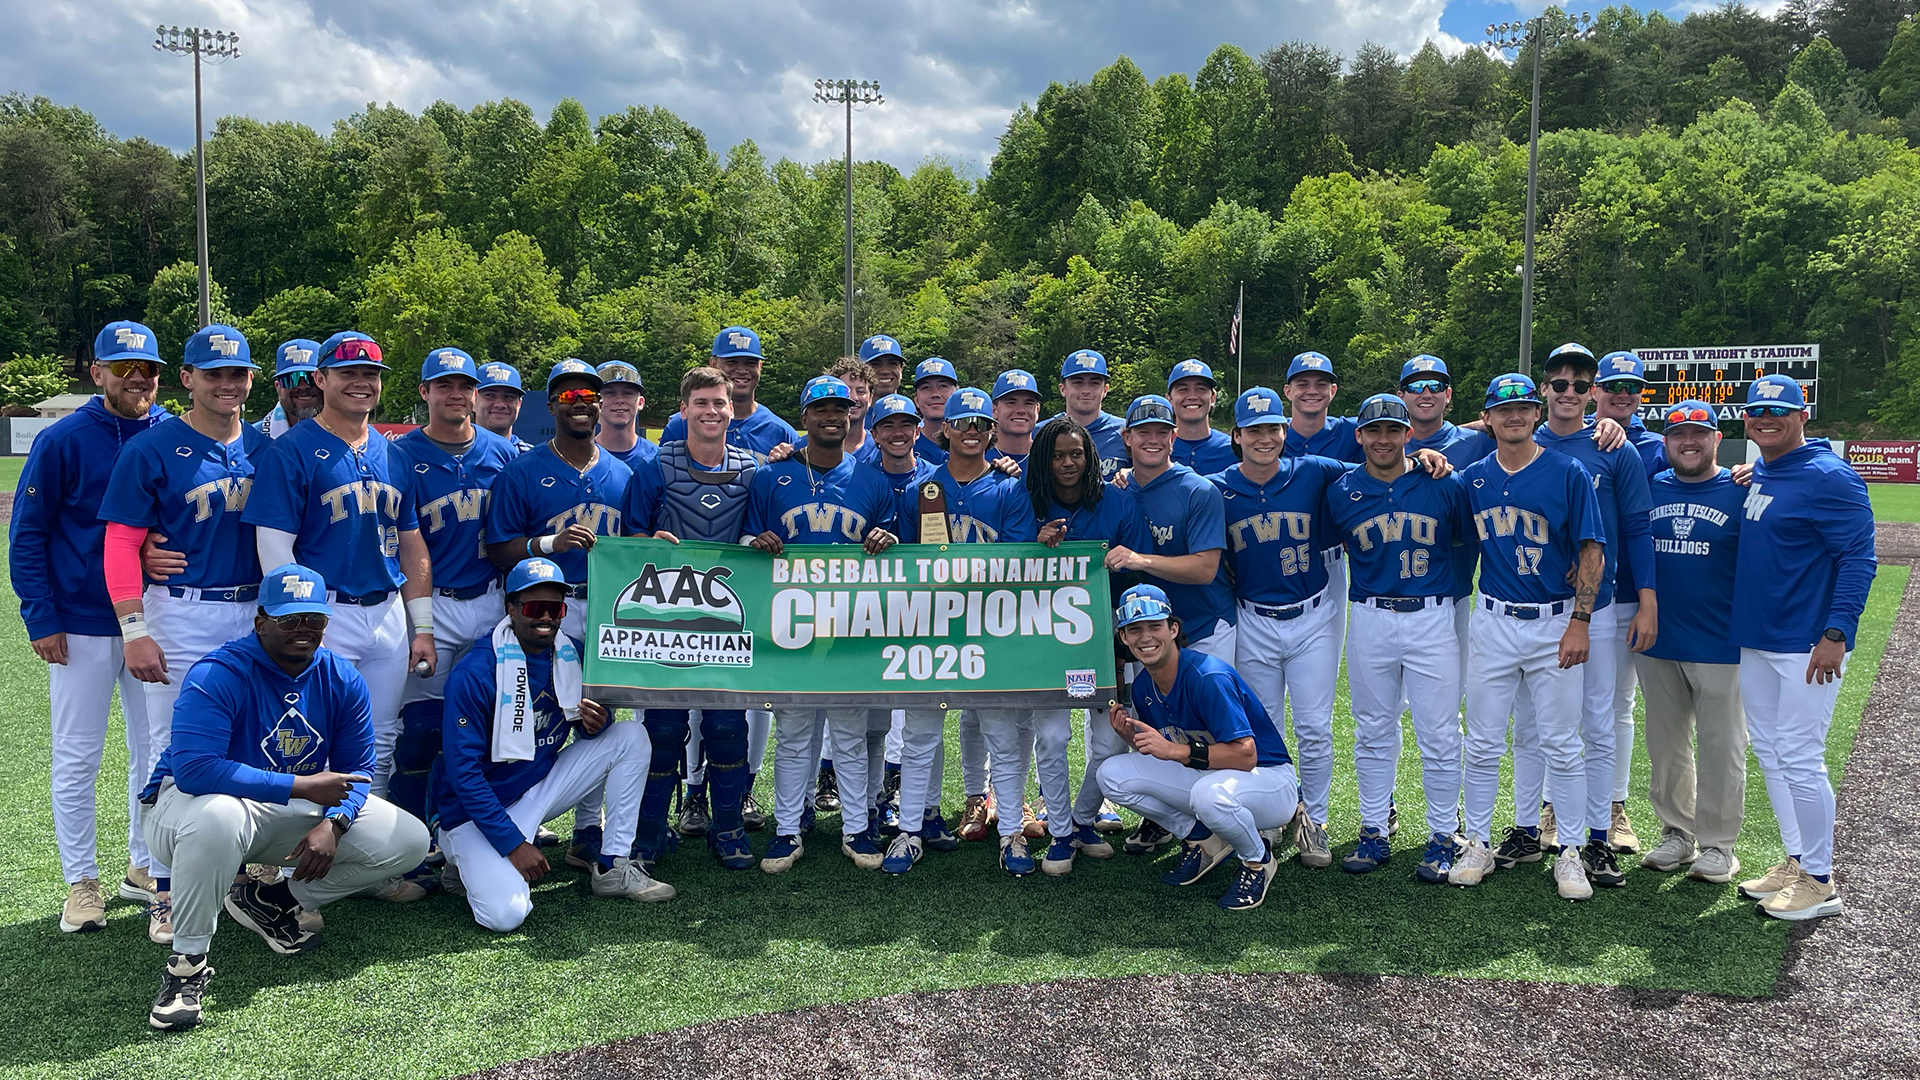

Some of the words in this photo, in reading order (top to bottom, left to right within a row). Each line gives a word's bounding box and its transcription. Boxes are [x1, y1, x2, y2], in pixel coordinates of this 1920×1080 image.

[1637, 349, 1689, 361] HUNTER
[1692, 348, 1748, 360] WRIGHT
[1750, 346, 1812, 358] STADIUM
[1678, 370, 1686, 382] 0
[1715, 369, 1723, 381] 0
[1849, 445, 1882, 454] Always
[1884, 446, 1903, 454] part
[1904, 445, 1915, 453] of
[1849, 454, 1884, 463] YOUR
[1887, 456, 1913, 464] team.
[185, 477, 253, 523] TW
[320, 480, 403, 524] TWU
[420, 488, 492, 533] TW
[1649, 503, 1685, 521] TENNESSEE
[1687, 503, 1729, 527] WESLEYAN
[780, 502, 867, 542] TWU
[949, 513, 999, 544] WU
[1228, 511, 1312, 552] TWU
[1351, 511, 1438, 552] TWU
[1473, 505, 1549, 545] TWU
[1280, 543, 1310, 576] 25
[1515, 545, 1543, 576] 17
[1655, 539, 1710, 555] BULLDOGS
[772, 558, 907, 584] BASEBALL
[916, 555, 1091, 583] TOURNAMENT
[1400, 548, 1430, 579] 16
[630, 562, 734, 608] AAC
[771, 586, 1094, 649] CHAMPIONS
[600, 628, 751, 651] APPALACHIAN
[601, 646, 662, 660] Athletic
[669, 650, 751, 664] Conference
[881, 644, 986, 680] 2026
[1067, 674, 1094, 685] NAIA
[513, 667, 526, 733] POWERADE
[276, 729, 311, 757] TW
